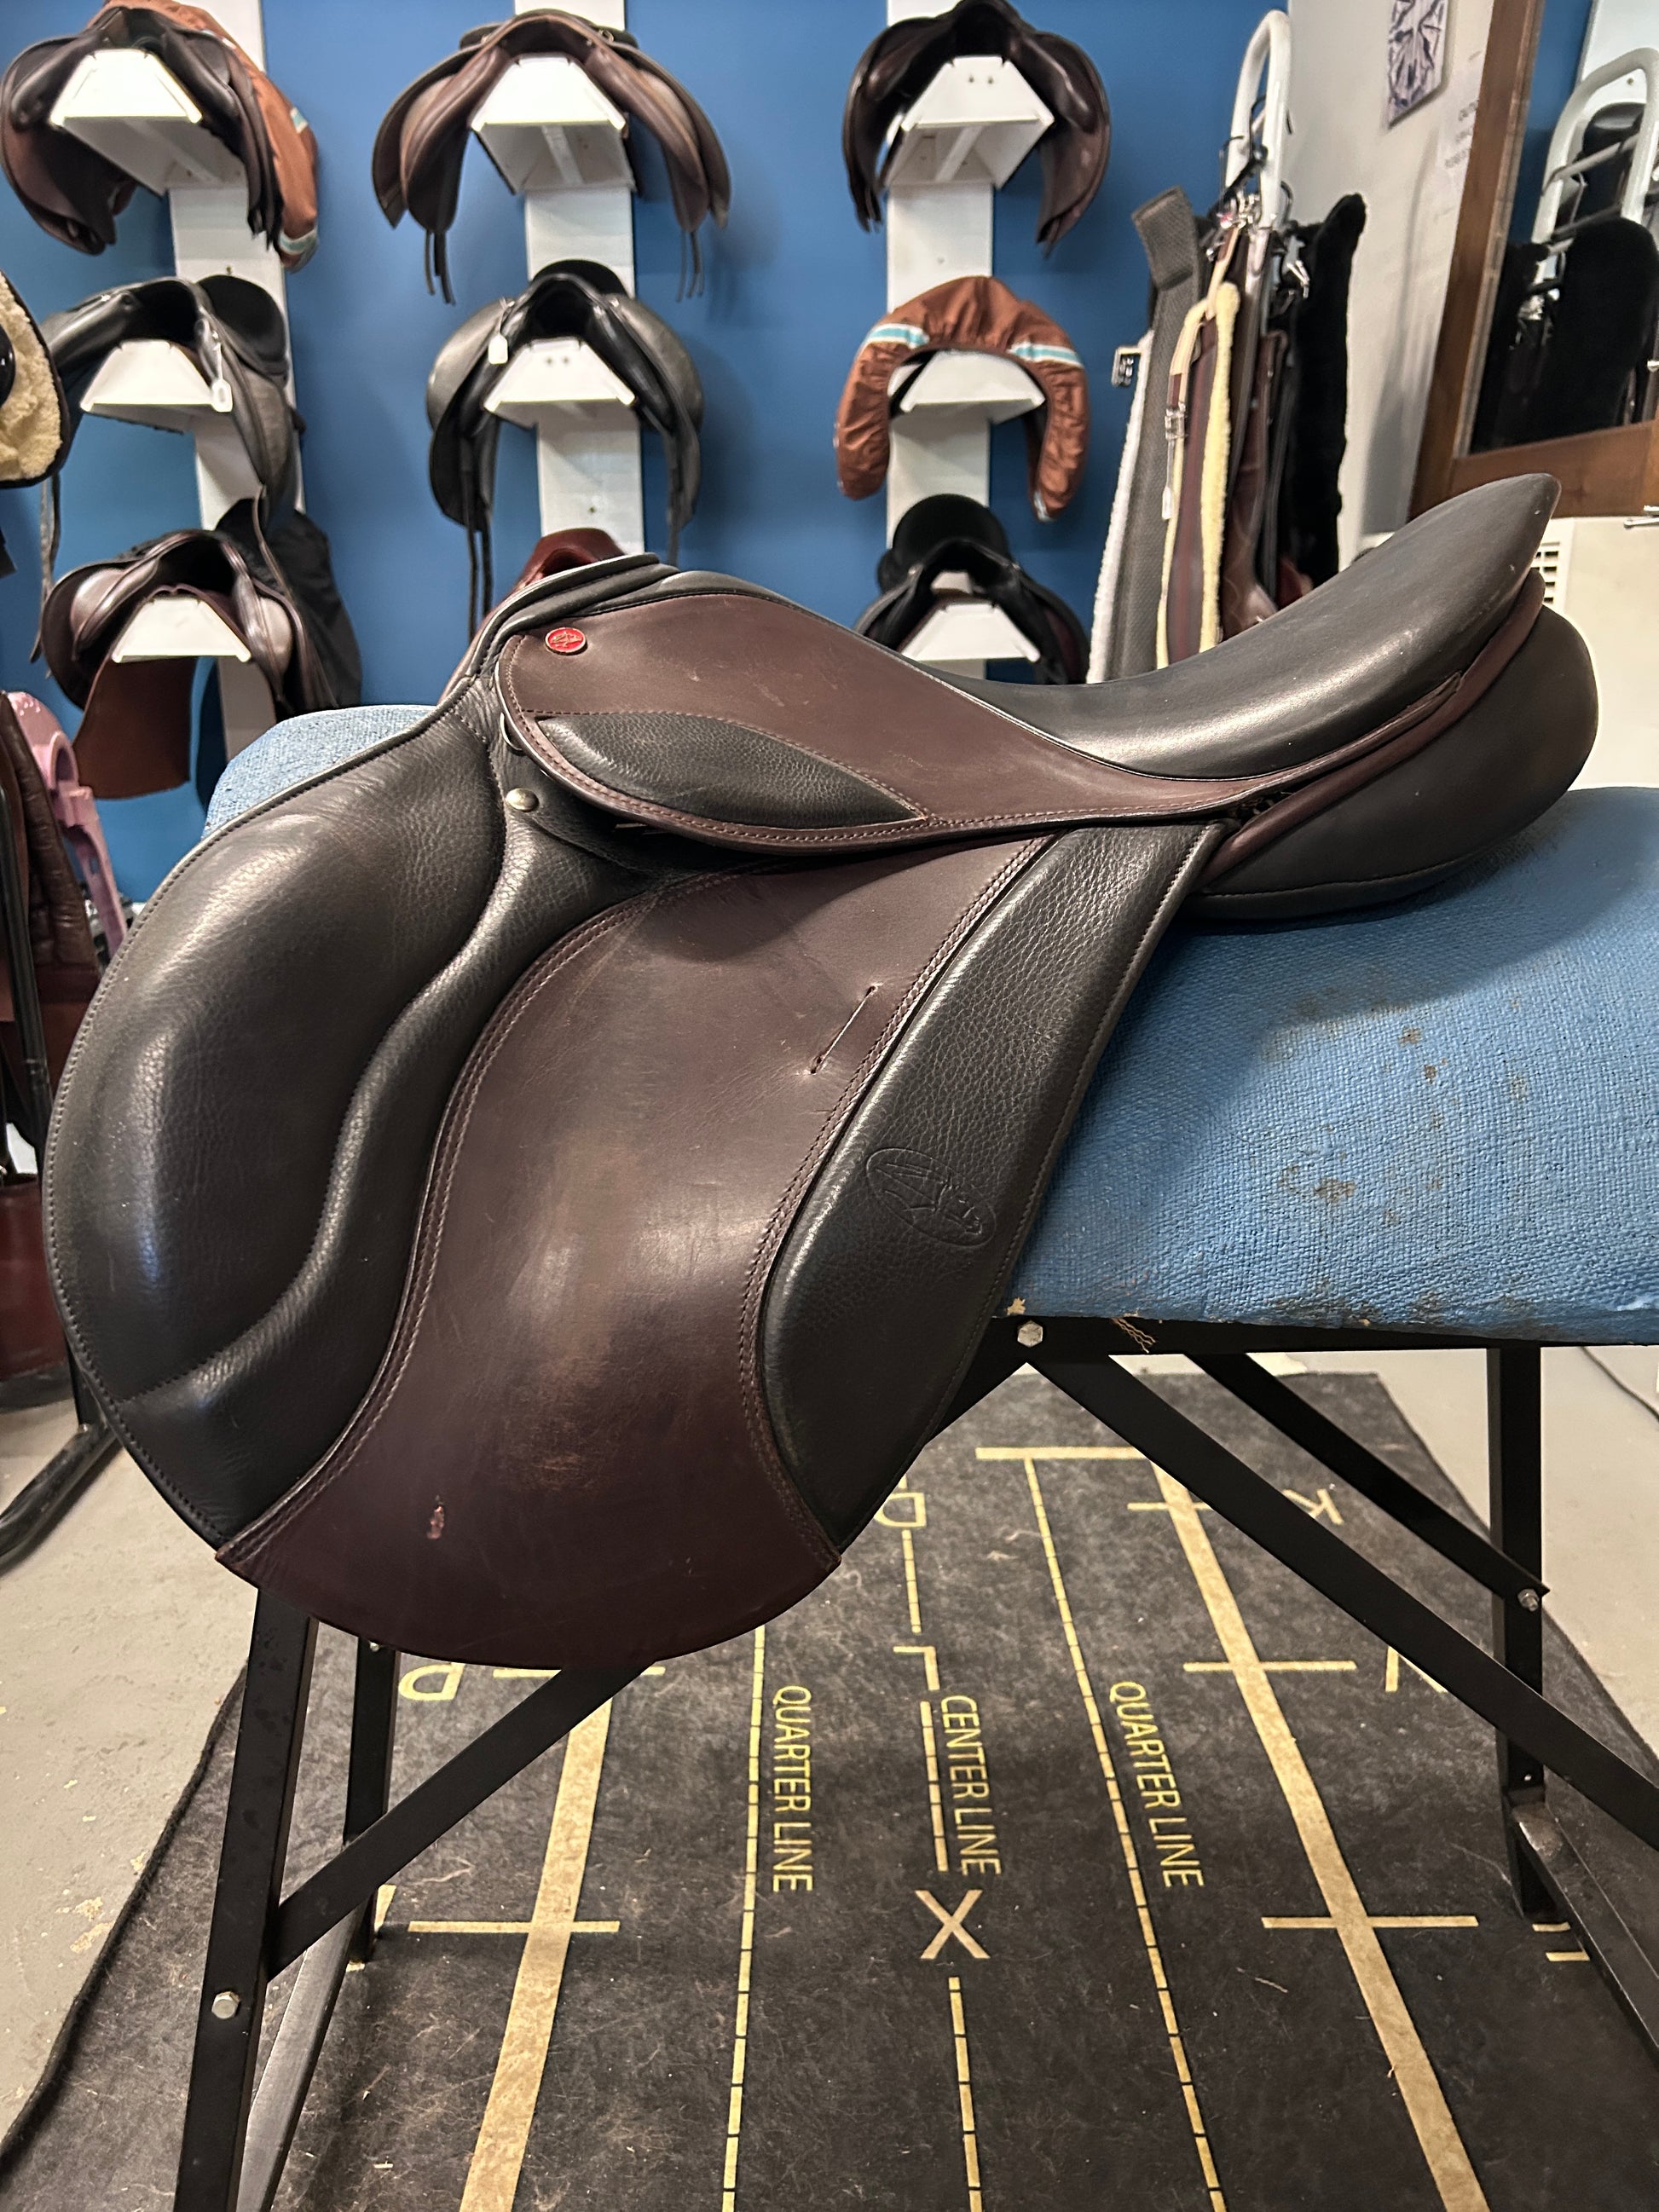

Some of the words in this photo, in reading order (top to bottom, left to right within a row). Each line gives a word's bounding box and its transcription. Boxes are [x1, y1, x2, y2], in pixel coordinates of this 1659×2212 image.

[873, 1493, 927, 1528] D
[893, 1645, 940, 1691] L
[772, 1685, 812, 1812] QUARTER
[940, 1695, 990, 1799] CENTER
[1109, 1681, 1182, 1809] QUARTER
[1148, 1816, 1205, 1888] LINE
[772, 1822, 813, 1892] LINE
[954, 1807, 1002, 1876] LINE
[915, 1889, 991, 1960] X
